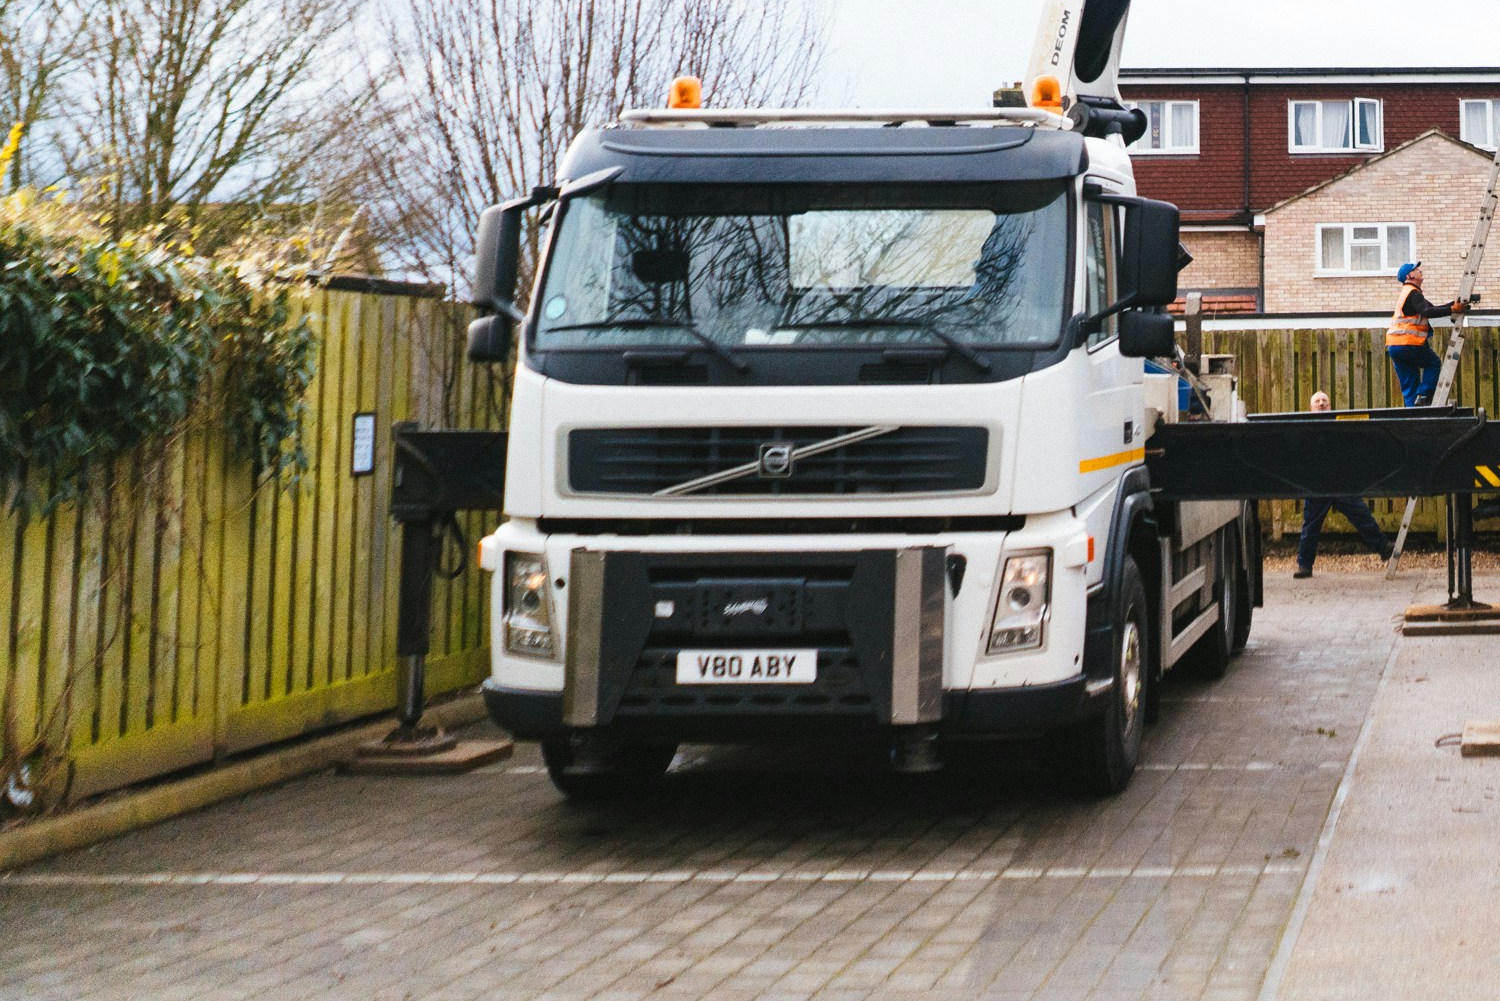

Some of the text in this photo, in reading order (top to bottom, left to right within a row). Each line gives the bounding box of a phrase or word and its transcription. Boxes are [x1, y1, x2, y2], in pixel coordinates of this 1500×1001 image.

[1051, 9, 1071, 67] DEOM
[698, 655, 797, 678] V80 ABY
